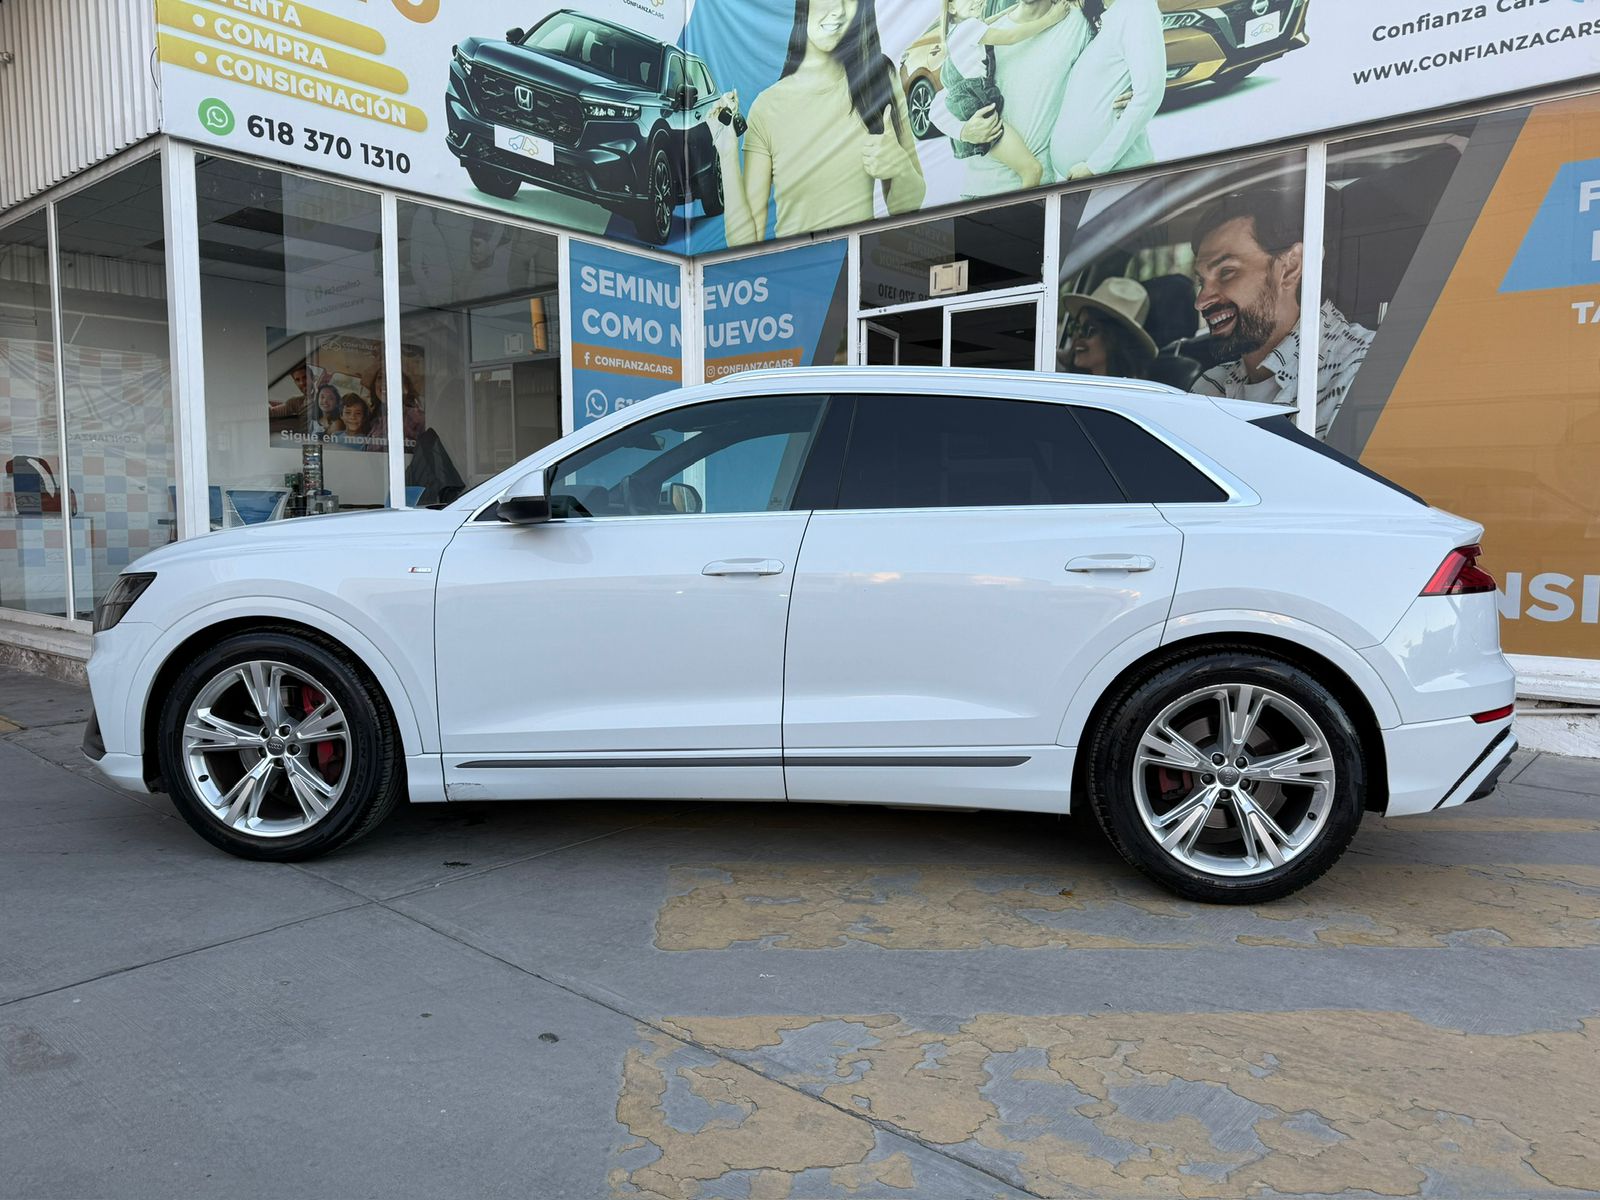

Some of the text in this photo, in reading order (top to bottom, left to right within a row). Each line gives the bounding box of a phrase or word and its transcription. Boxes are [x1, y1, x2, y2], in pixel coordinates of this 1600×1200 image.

[219, 0, 303, 27] NTA
[1372, 0, 1550, 42] Confianza Ca
[213, 17, 328, 69] COMPRA
[216, 54, 407, 125] CONSIGNACIÓN
[247, 114, 411, 174] 618 370 1310
[581, 307, 663, 345] COMO
[594, 356, 674, 375] CONFIANZACARS
[717, 358, 793, 376] CONFIANZACARS
[280, 429, 417, 448] Sigue en movimto
